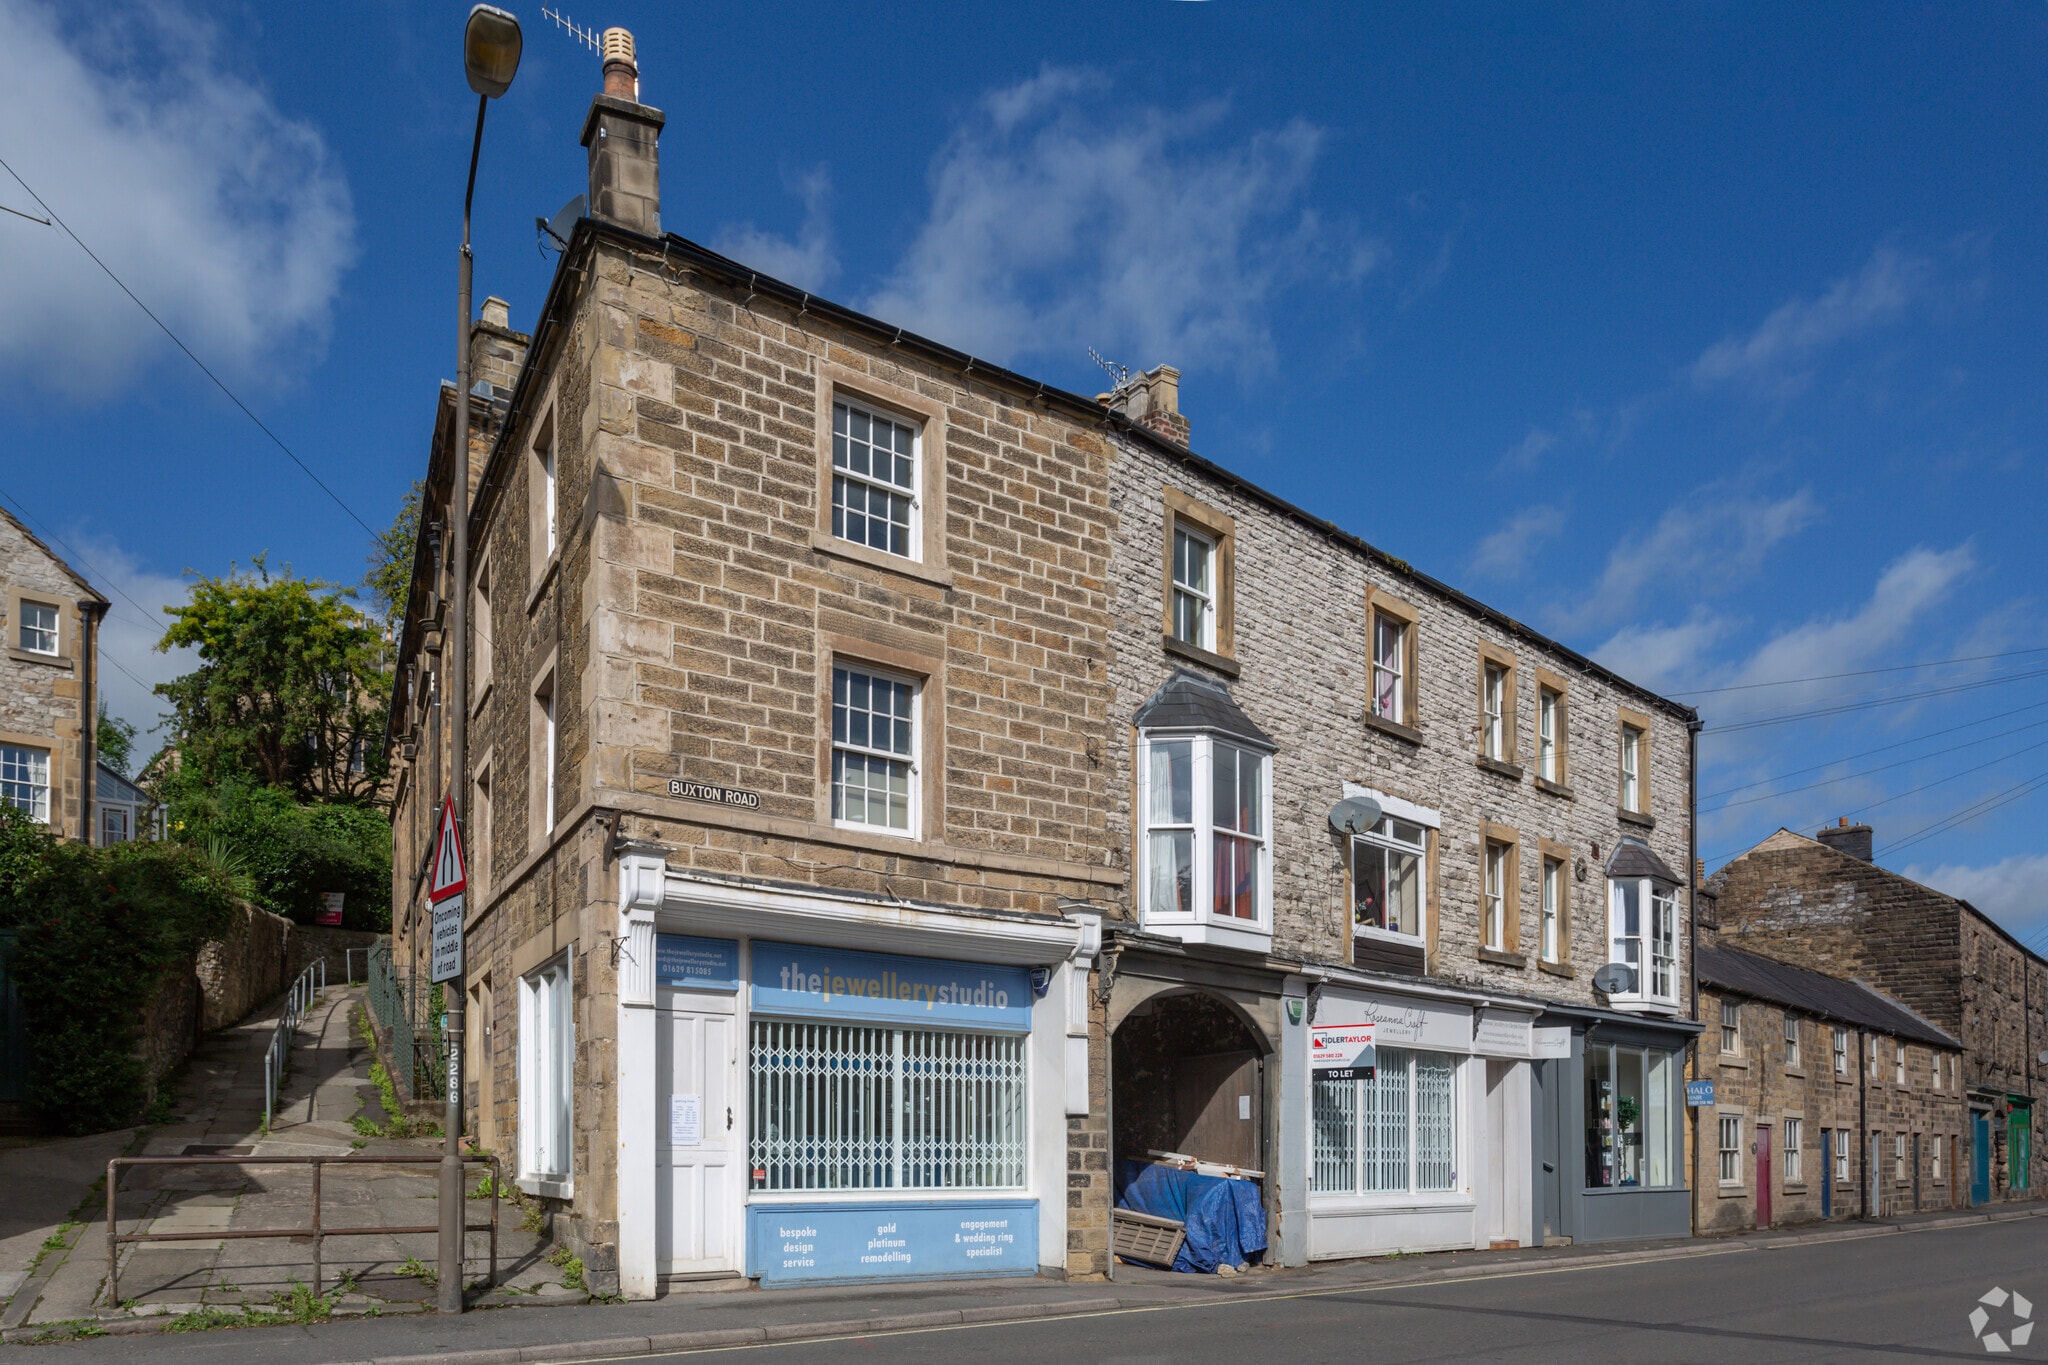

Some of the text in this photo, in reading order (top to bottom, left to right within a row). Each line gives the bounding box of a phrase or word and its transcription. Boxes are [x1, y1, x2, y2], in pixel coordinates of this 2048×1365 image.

[671, 781, 757, 807] BUXTON ROAD
[435, 905, 460, 925] Oncoming
[436, 923, 457, 941] vehicles
[434, 939, 458, 959] in middle
[437, 956, 456, 974] of road
[662, 964, 712, 976] 01629 815085
[1328, 1069, 1354, 1078] TO LET
[1687, 1086, 1713, 1095] HALO
[877, 1223, 897, 1236] gold
[960, 1219, 1008, 1230] engagement
[780, 1227, 817, 1240] bespoke
[954, 1231, 1014, 1244] & wedding ring
[783, 1242, 814, 1255] design
[868, 1238, 906, 1251] platinum
[861, 1251, 911, 1265] remodelling
[966, 1247, 1003, 1258] specialist
[783, 1257, 815, 1268] service
